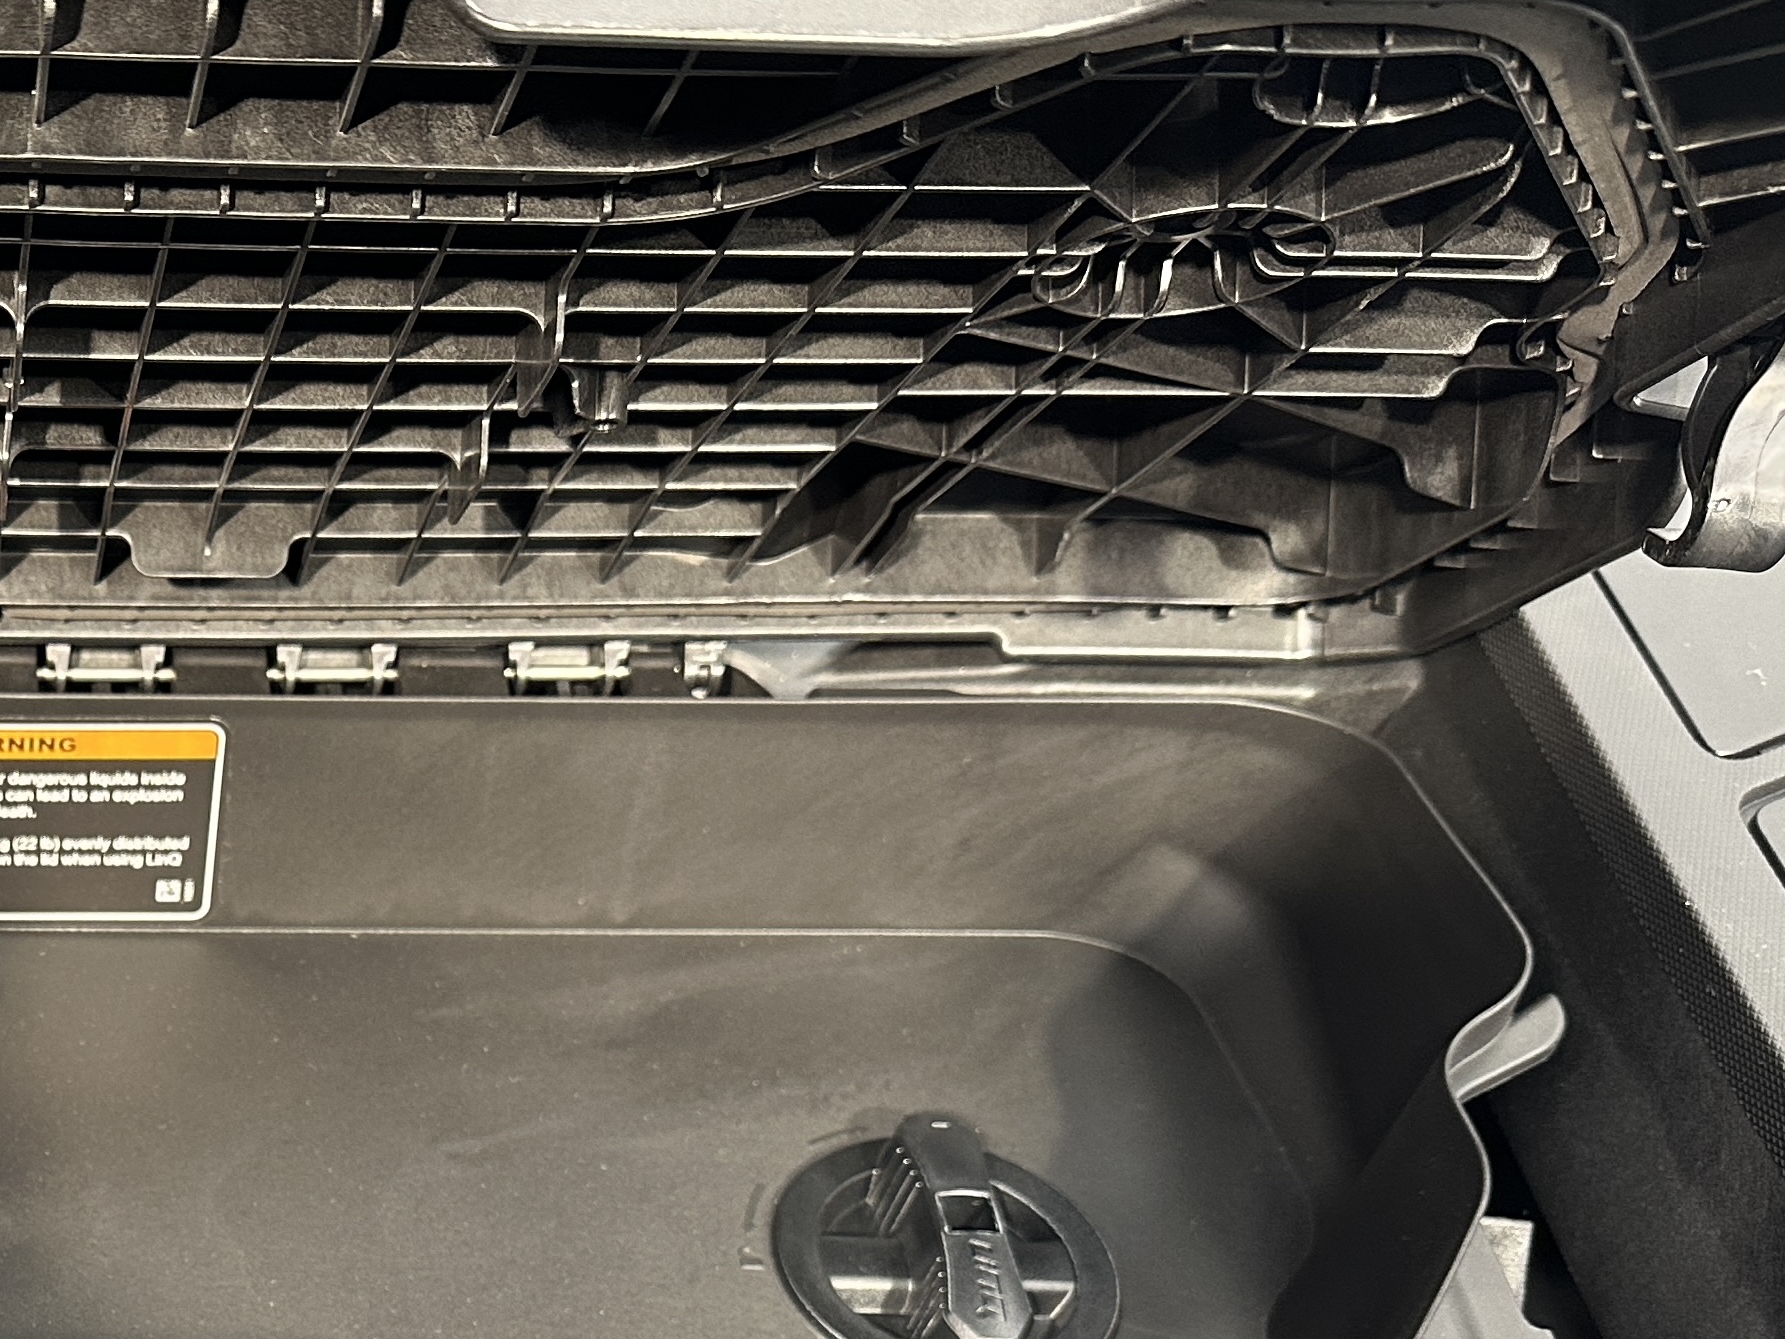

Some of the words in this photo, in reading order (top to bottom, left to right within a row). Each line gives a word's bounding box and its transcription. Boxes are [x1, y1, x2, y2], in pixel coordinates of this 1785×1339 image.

[7, 770, 87, 788] dangerous
[89, 771, 138, 787] liquids
[140, 770, 186, 785] inside
[5, 789, 34, 801] can
[71, 788, 88, 801] to
[89, 790, 110, 801] an
[112, 788, 184, 805] explosion
[12, 835, 38, 852] (22
[62, 835, 111, 853] evenly
[112, 835, 190, 850] distributed
[14, 853, 38, 866] the
[40, 853, 59, 866] lid
[60, 853, 101, 866] when
[103, 853, 144, 869] using
